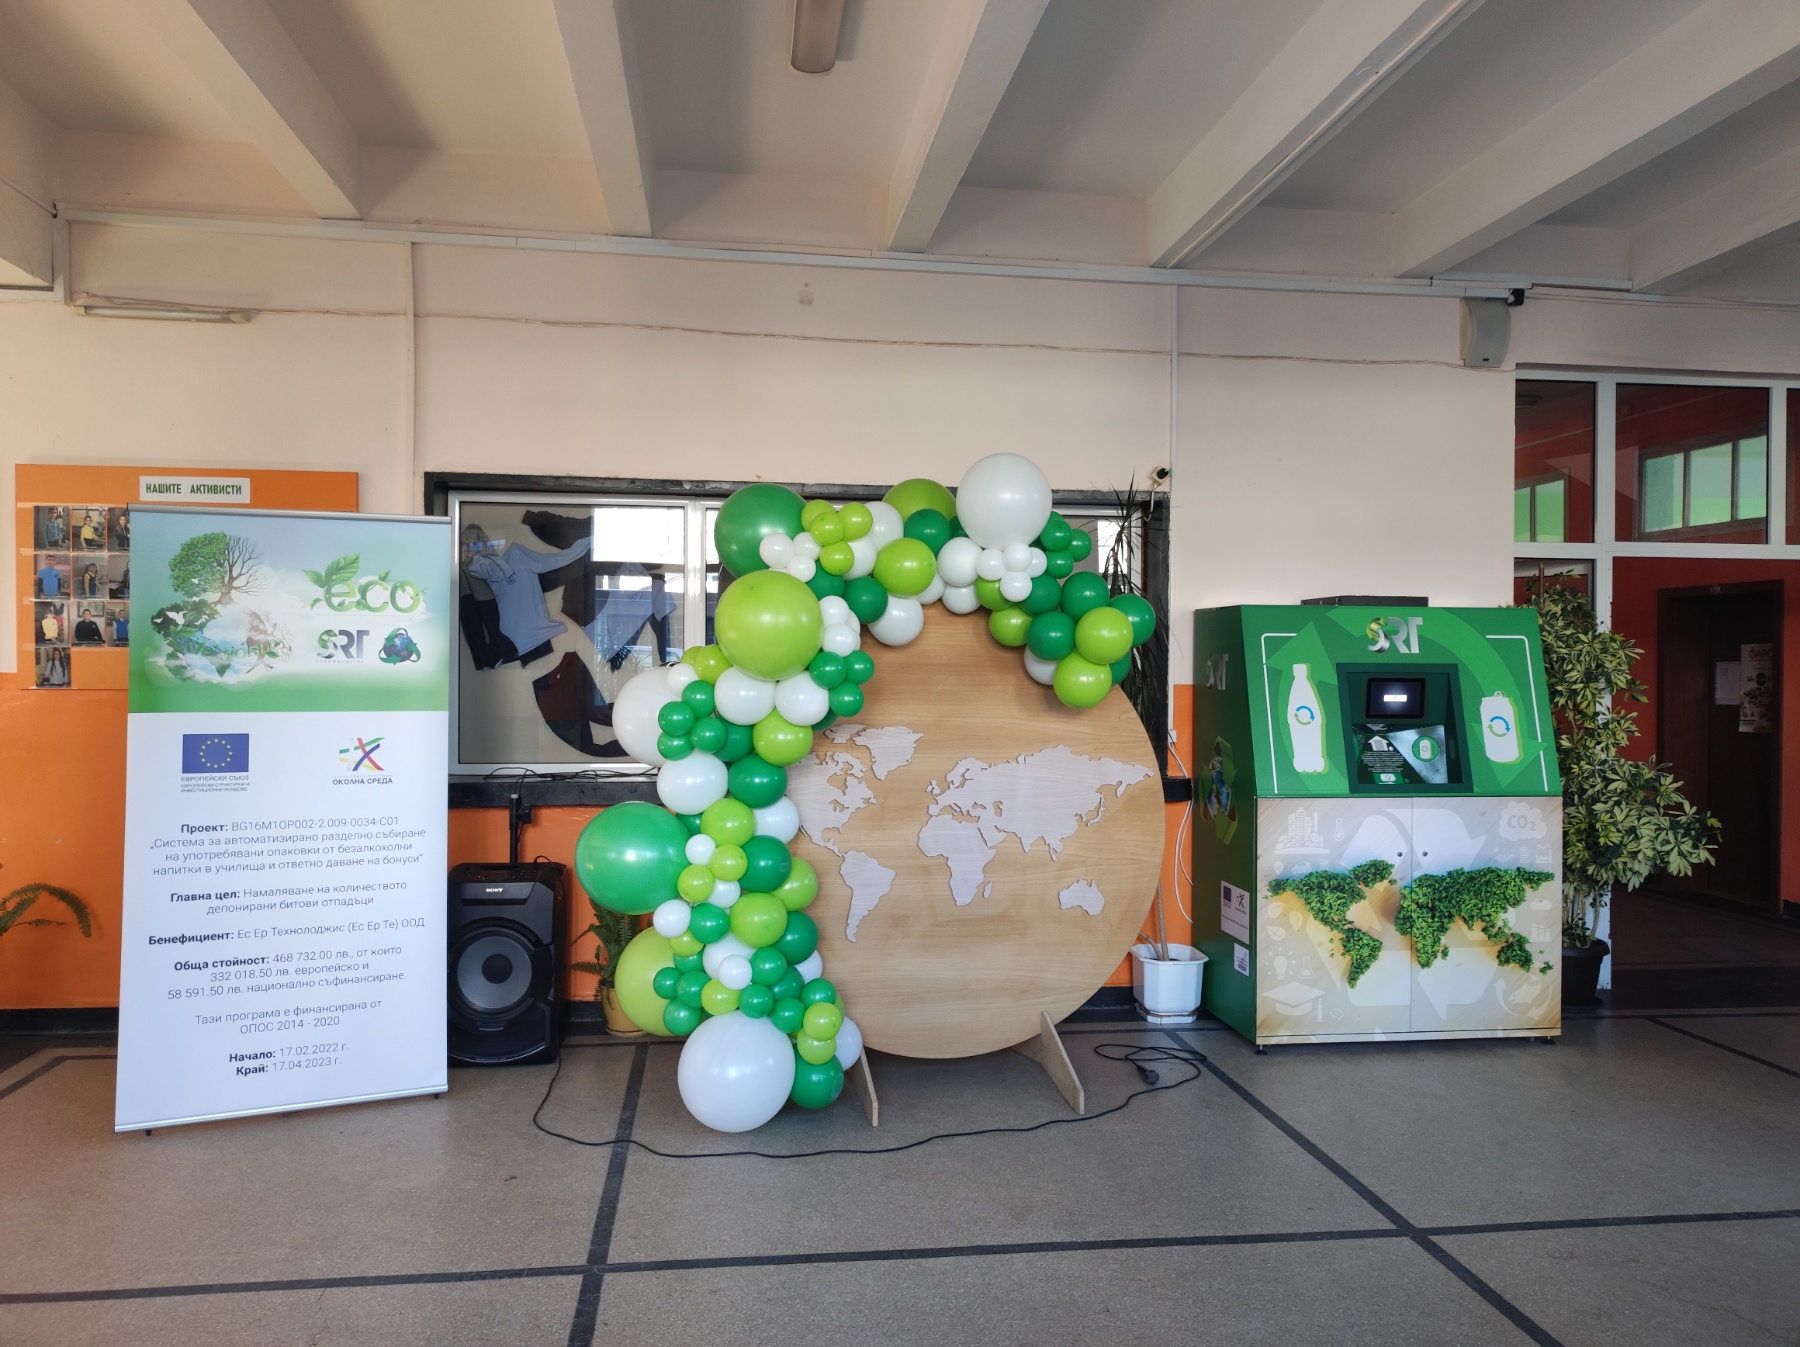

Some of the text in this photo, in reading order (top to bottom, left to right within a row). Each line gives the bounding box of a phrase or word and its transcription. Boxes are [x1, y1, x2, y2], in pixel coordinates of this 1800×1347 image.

[145, 482, 242, 496] НАШИТЕ АКТИВИСТИ
[317, 629, 370, 660] SRT
[1366, 616, 1423, 653] SRT
[332, 777, 393, 786] ОКОЛНА СРЕДА
[181, 824, 229, 836] Проект:
[225, 835, 319, 846] автоматизирано
[322, 832, 374, 844] разделно
[376, 829, 426, 840] събиране
[166, 844, 413, 864] на употребявани опаковки от безалкохолни
[153, 867, 202, 876] напитки
[205, 866, 212, 874] в
[215, 863, 266, 876] училища
[278, 860, 324, 870] ответно
[326, 859, 365, 869] даване
[171, 893, 212, 903] Главна
[215, 891, 241, 902] цел:
[244, 887, 315, 899] Намаляване
[334, 882, 408, 893] количеството
[207, 898, 374, 916] депонирани битови отпадъци
[149, 918, 425, 946] Бенефициент: Ес Ер Технолоджис (Ес Ер Те) ООД
[174, 960, 209, 972] Обща
[212, 957, 270, 969] стойност:
[273, 953, 294, 964] 468
[296, 950, 333, 962] 732.00
[357, 950, 369, 958] от
[372, 947, 402, 956] които
[211, 971, 232, 983] 332
[235, 968, 273, 980] 018.50
[275, 969, 292, 977] лв.
[295, 963, 360, 977] европейско
[168, 973, 407, 1000] 58 591.50 лв. национално съфинансиране.
[195, 1001, 383, 1025] Тази програма е финансирана от
[240, 1022, 274, 1035] ОПОС
[277, 1019, 305, 1031] 2014
[314, 1016, 340, 1028] 2020
[229, 1043, 350, 1063] Начало: 17.02.2022 г.
[236, 1057, 343, 1078] Край: 17.04.2023 г.
